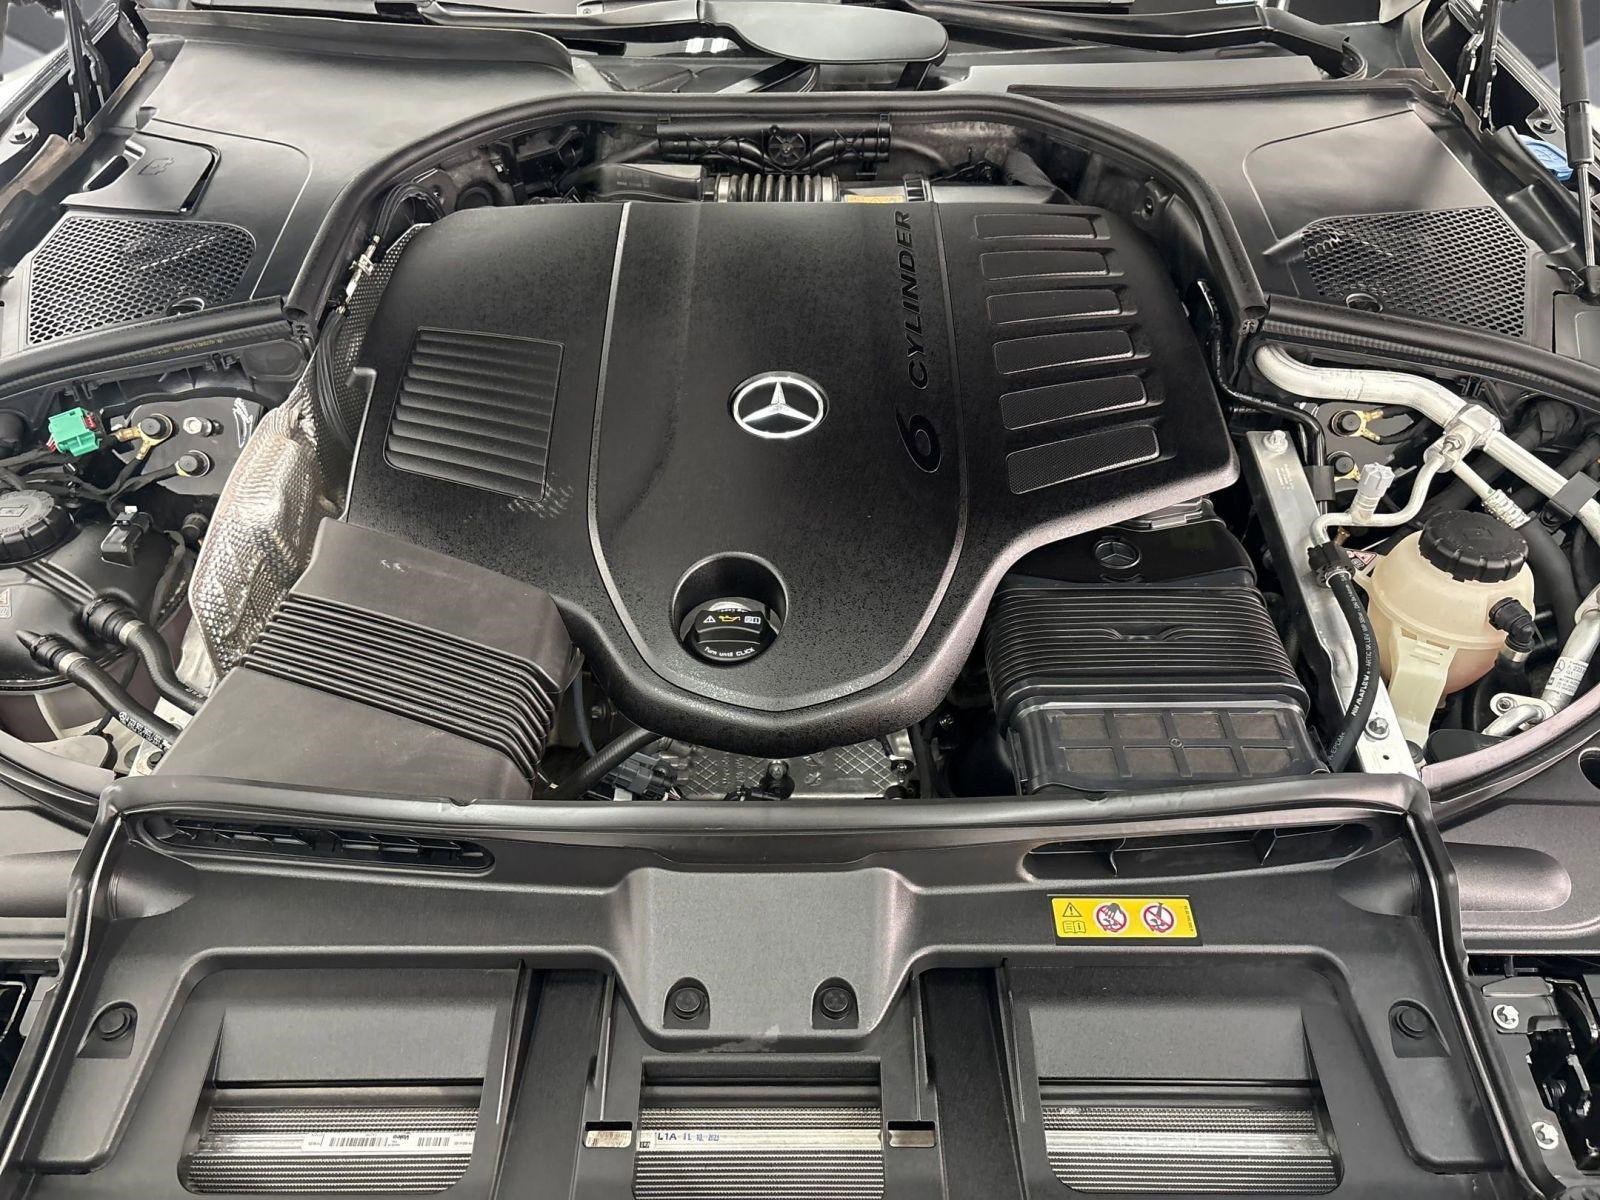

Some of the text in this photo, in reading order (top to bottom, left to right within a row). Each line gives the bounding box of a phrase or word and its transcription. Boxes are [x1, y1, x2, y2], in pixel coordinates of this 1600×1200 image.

[895, 210, 941, 473] 6 CYLINDER
[704, 646, 718, 656] Turn
[735, 646, 756, 657] CLICK
